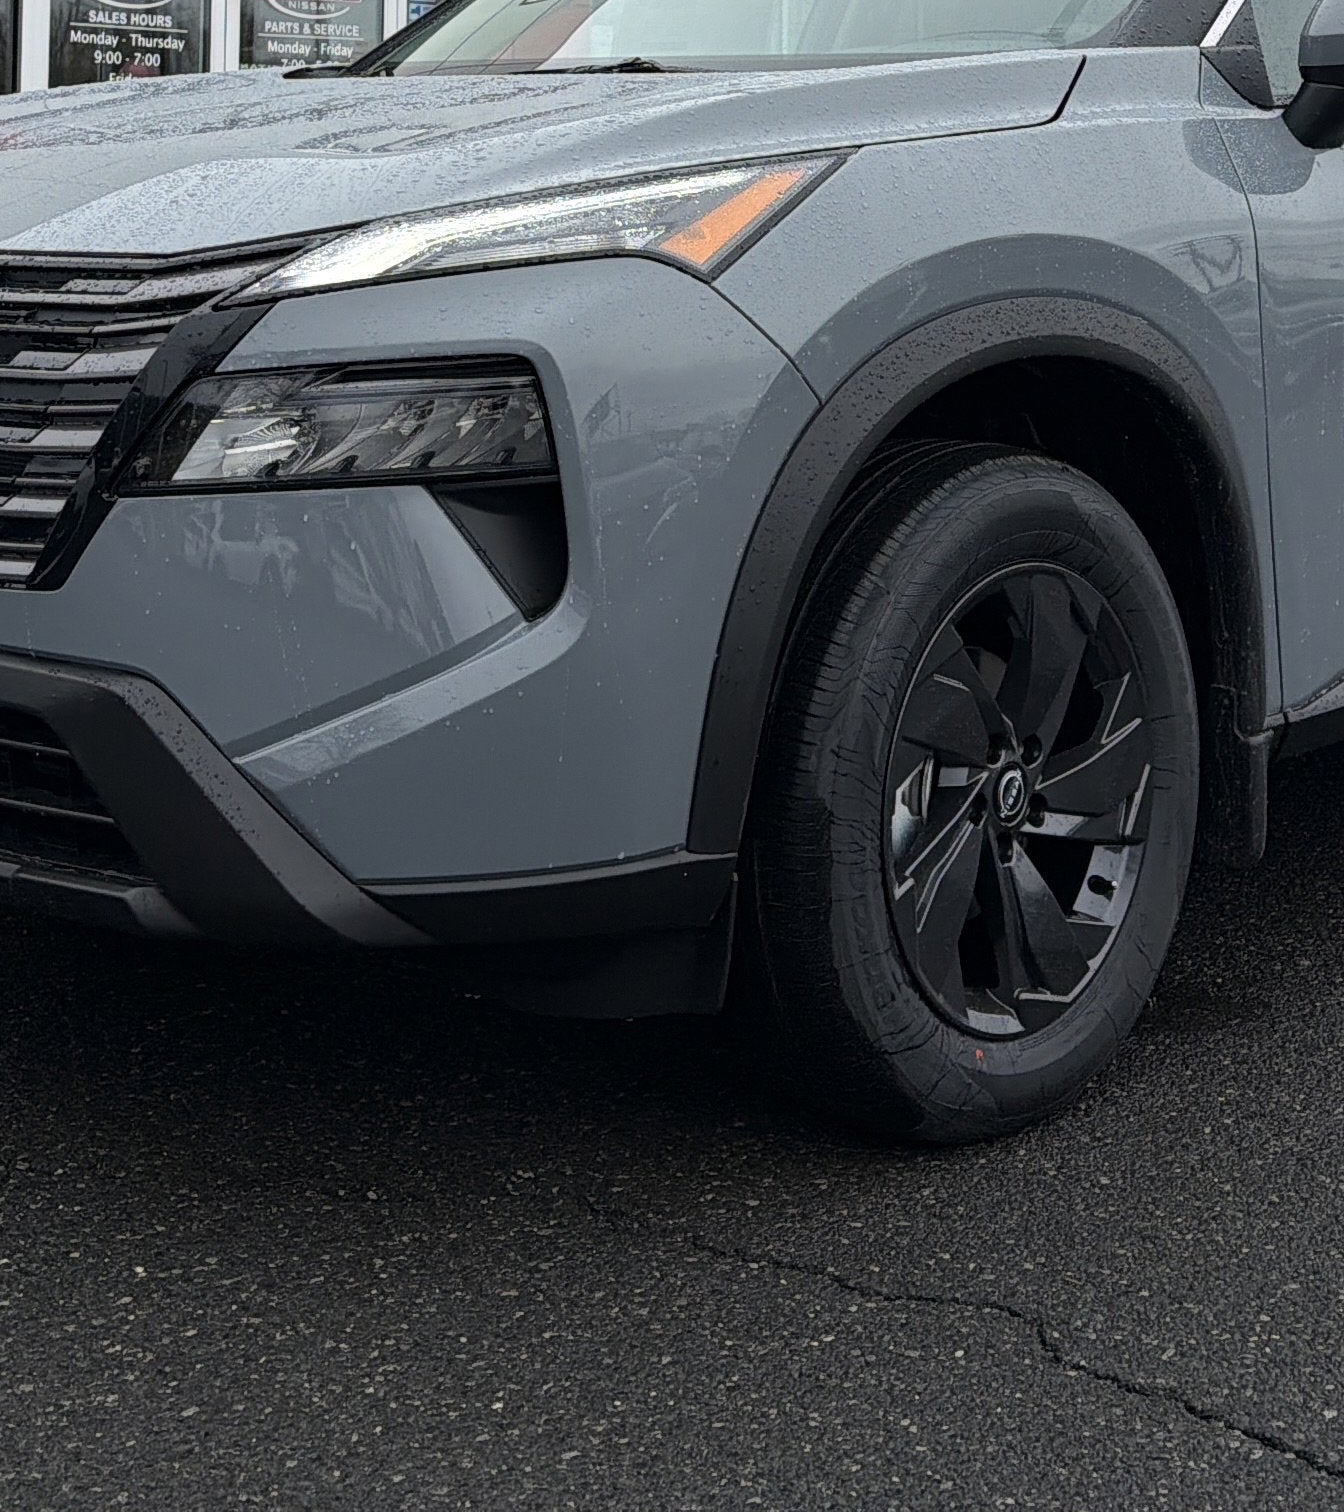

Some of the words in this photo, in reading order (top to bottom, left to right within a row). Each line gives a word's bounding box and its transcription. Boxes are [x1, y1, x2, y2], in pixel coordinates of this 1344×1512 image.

[288, 1, 335, 11] NISSAN
[88, 10, 128, 24] SALES
[130, 13, 172, 27] HOURS
[264, 21, 299, 33] PARTS
[303, 24, 311, 34] &
[314, 24, 359, 36] SERVICE
[70, 29, 119, 48] Monday
[129, 34, 185, 52] Thursday
[267, 40, 311, 56] Monday
[320, 42, 354, 57] Friday
[93, 51, 122, 64] 9:00
[134, 53, 161, 66] 7:00
